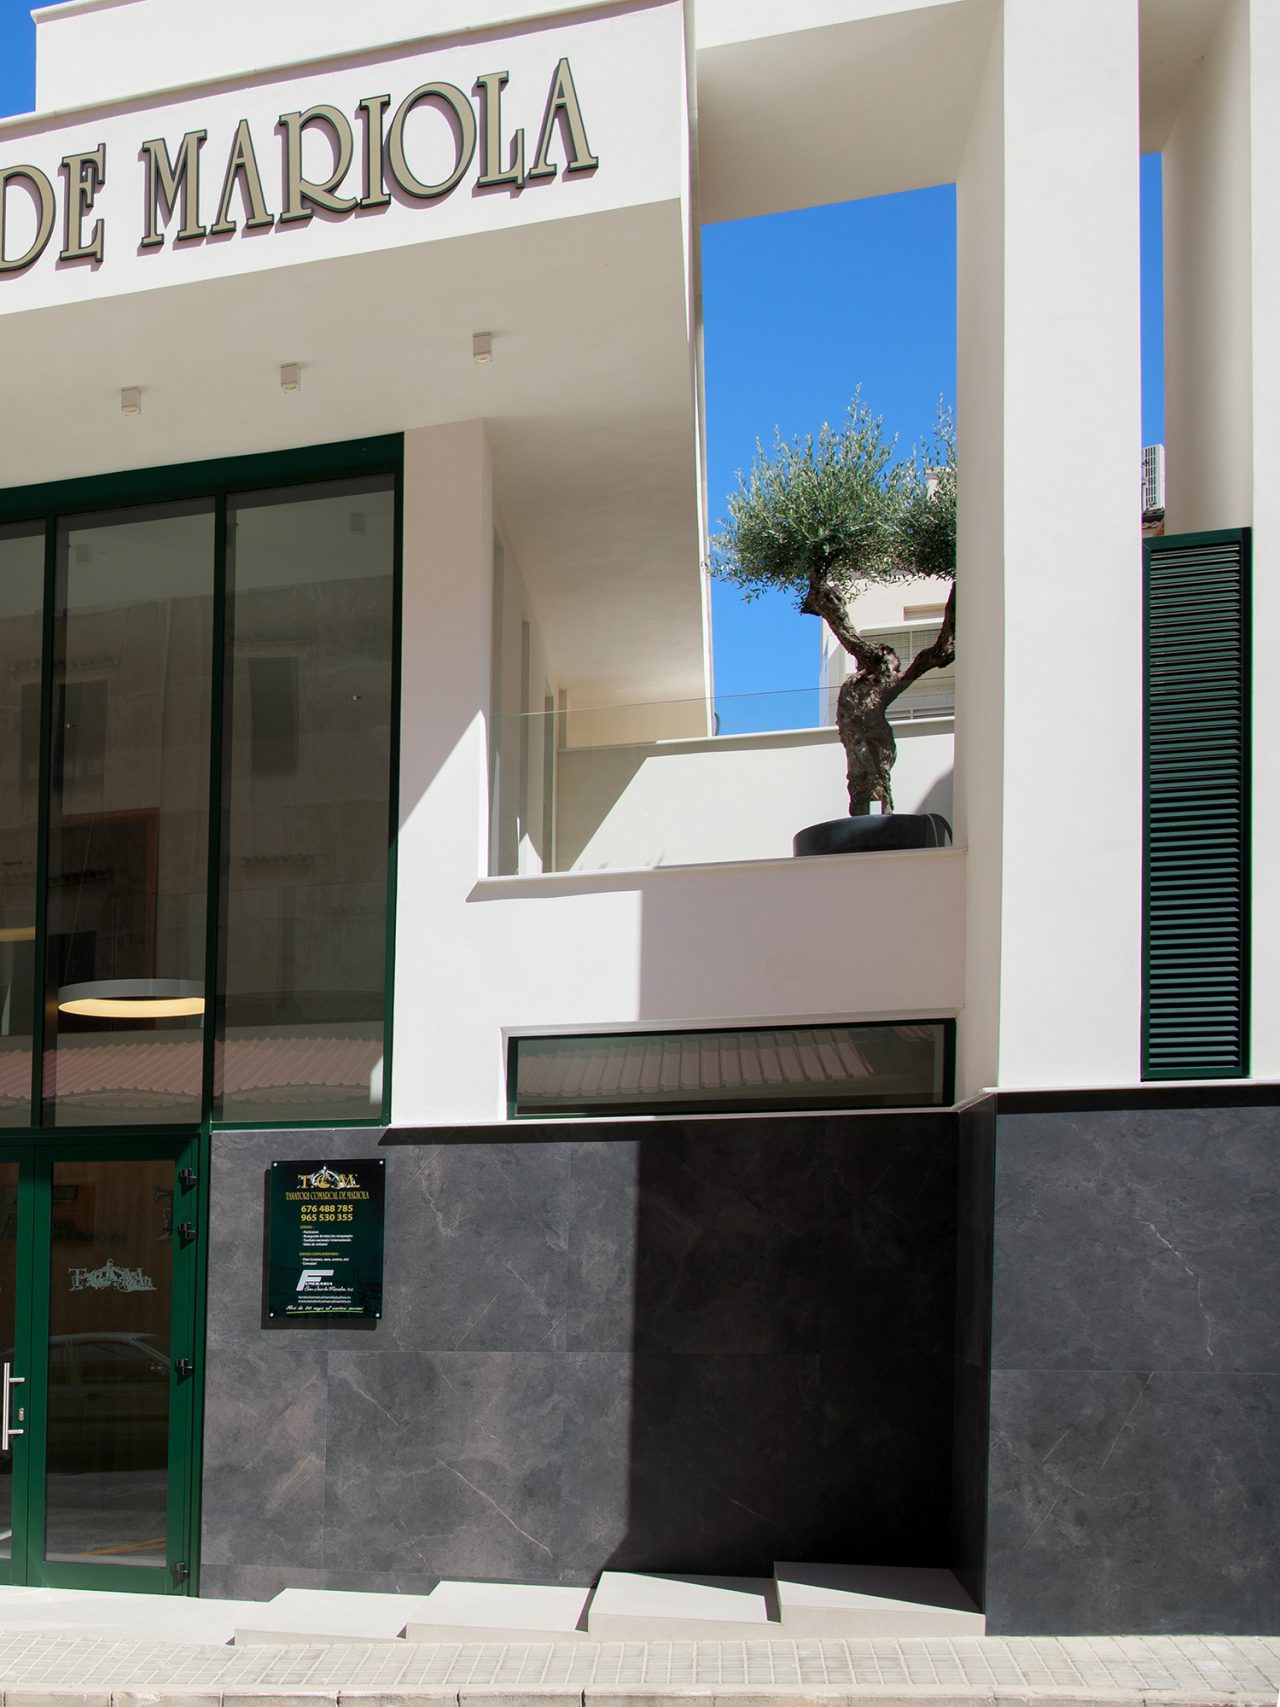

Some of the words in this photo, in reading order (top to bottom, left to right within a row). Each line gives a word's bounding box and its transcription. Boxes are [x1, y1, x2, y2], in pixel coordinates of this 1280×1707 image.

[140, 57, 599, 248] MARIOLA
[301, 1205, 317, 1213] 676
[319, 1205, 336, 1213] 488
